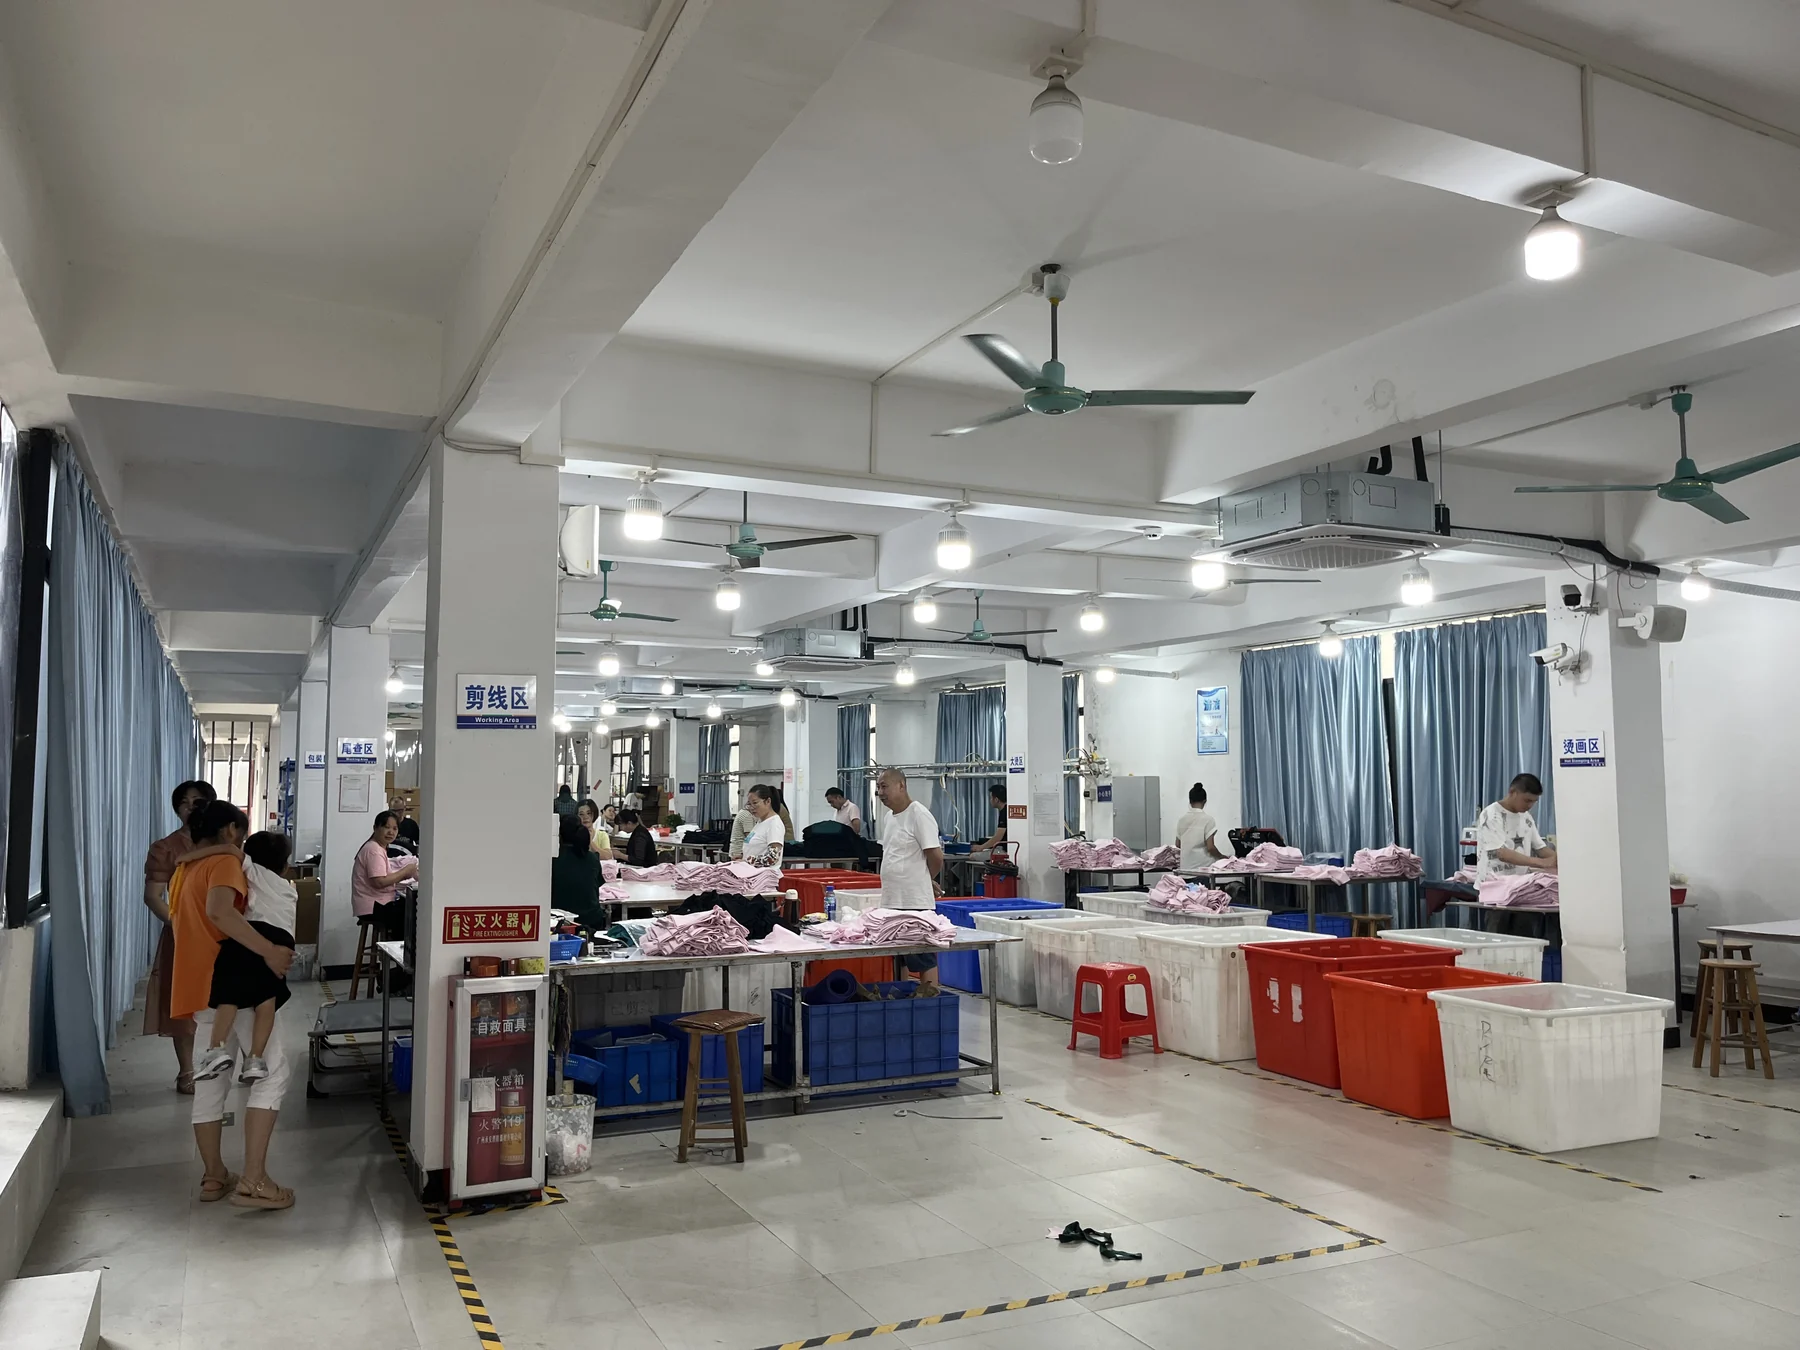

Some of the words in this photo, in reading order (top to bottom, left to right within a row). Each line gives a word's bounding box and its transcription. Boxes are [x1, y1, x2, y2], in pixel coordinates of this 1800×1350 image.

[465, 685, 529, 710] 剪线区
[342, 743, 373, 755] 尾查区
[1563, 738, 1600, 754] 烫画区
[473, 912, 519, 929] 灭火器
[478, 1018, 526, 1035] 自救面具
